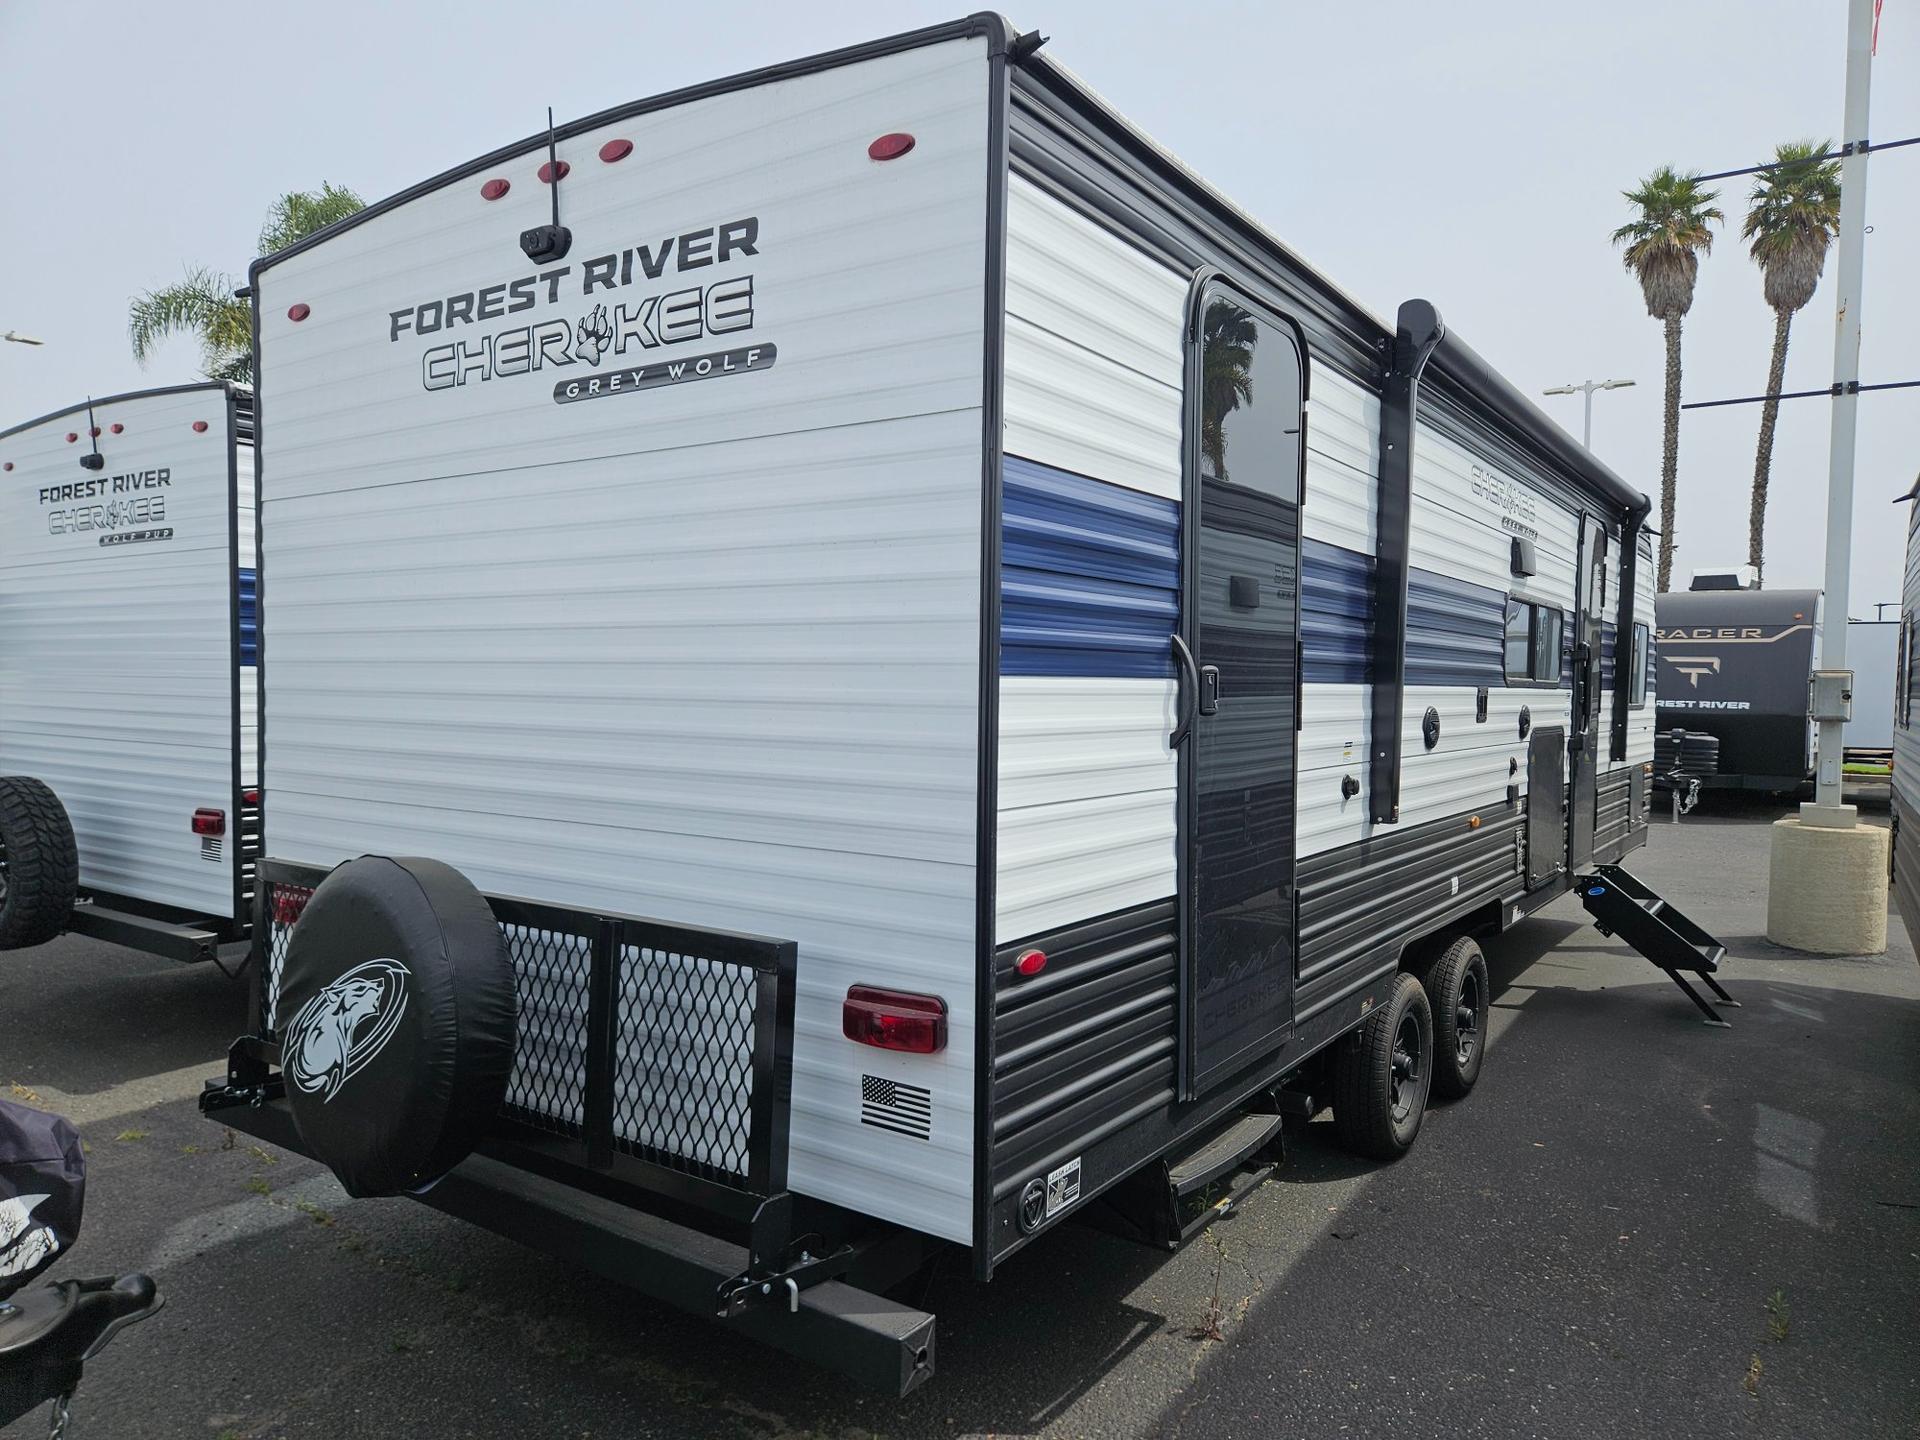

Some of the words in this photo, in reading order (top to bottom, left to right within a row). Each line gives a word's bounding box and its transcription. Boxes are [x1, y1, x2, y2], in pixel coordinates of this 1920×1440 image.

[389, 266, 571, 342] FOREST
[582, 216, 760, 295] RIVER
[566, 371, 646, 399] GREY
[668, 348, 761, 381] WOLF
[39, 478, 108, 505] FOREST
[112, 468, 172, 494] RIVER
[103, 532, 136, 544] WOLF
[145, 529, 169, 540] PUP
[1698, 701, 1750, 710] RIVER
